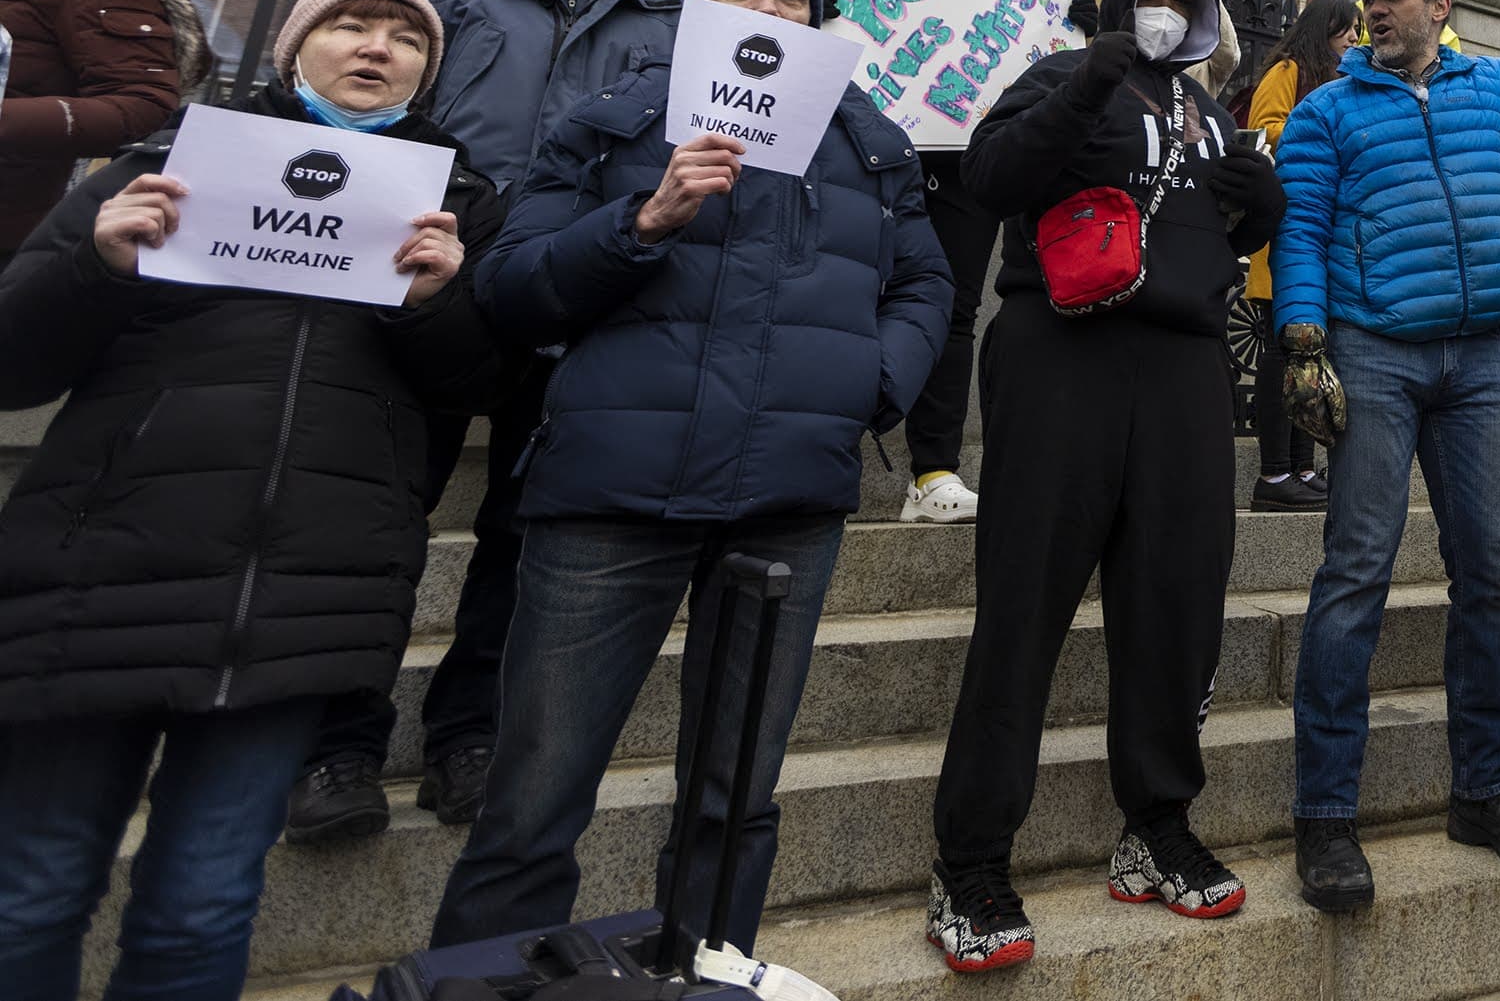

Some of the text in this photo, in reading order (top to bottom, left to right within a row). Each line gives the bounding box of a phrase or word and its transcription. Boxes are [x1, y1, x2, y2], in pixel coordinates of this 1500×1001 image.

[739, 48, 777, 65] STOP
[710, 80, 776, 118] WAR
[690, 113, 778, 146] IN UKRAINE
[1173, 101, 1185, 131] NEW
[292, 167, 341, 183] STOP
[252, 205, 344, 240] WAR
[208, 241, 354, 271] IN UKRAINE
[1100, 264, 1147, 306] YORK
